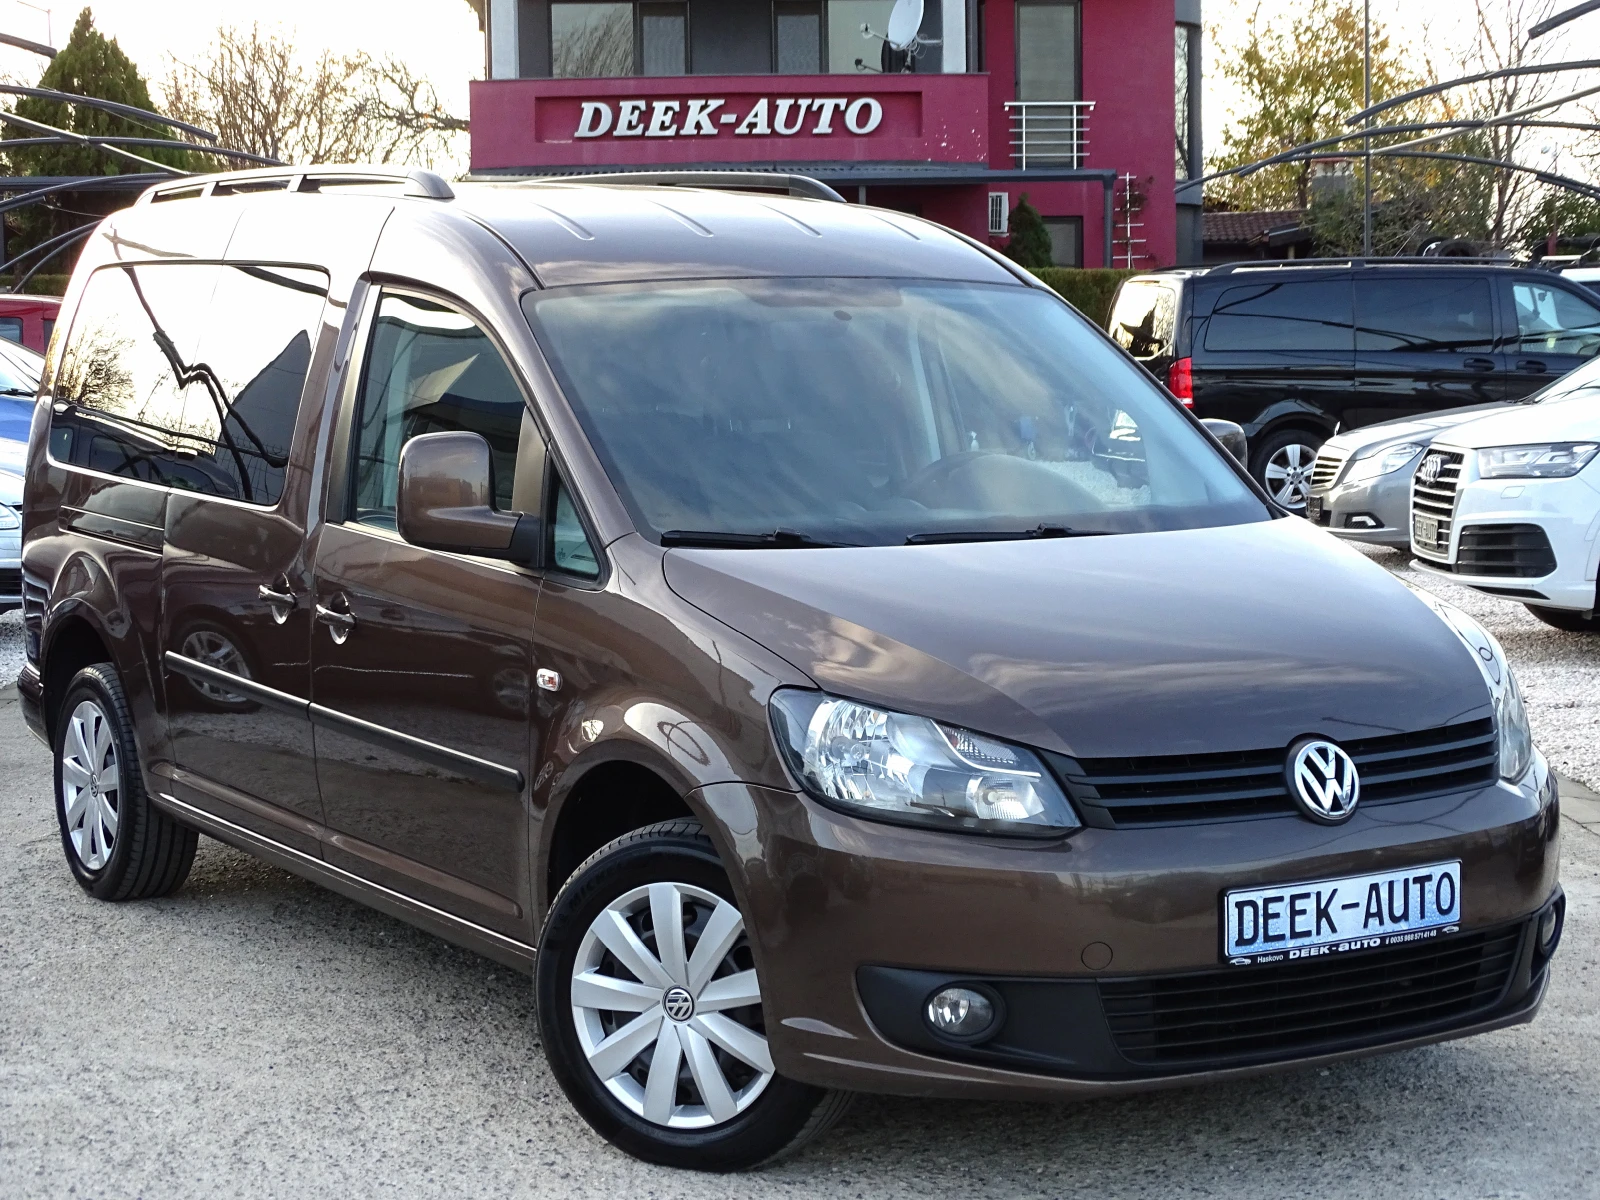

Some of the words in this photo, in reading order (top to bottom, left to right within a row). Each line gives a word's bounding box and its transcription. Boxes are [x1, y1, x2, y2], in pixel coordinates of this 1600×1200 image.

[574, 97, 883, 138] DEEK-AUTO
[1234, 871, 1456, 947] DEEK-AUTO
[1257, 954, 1284, 964] Haskovo
